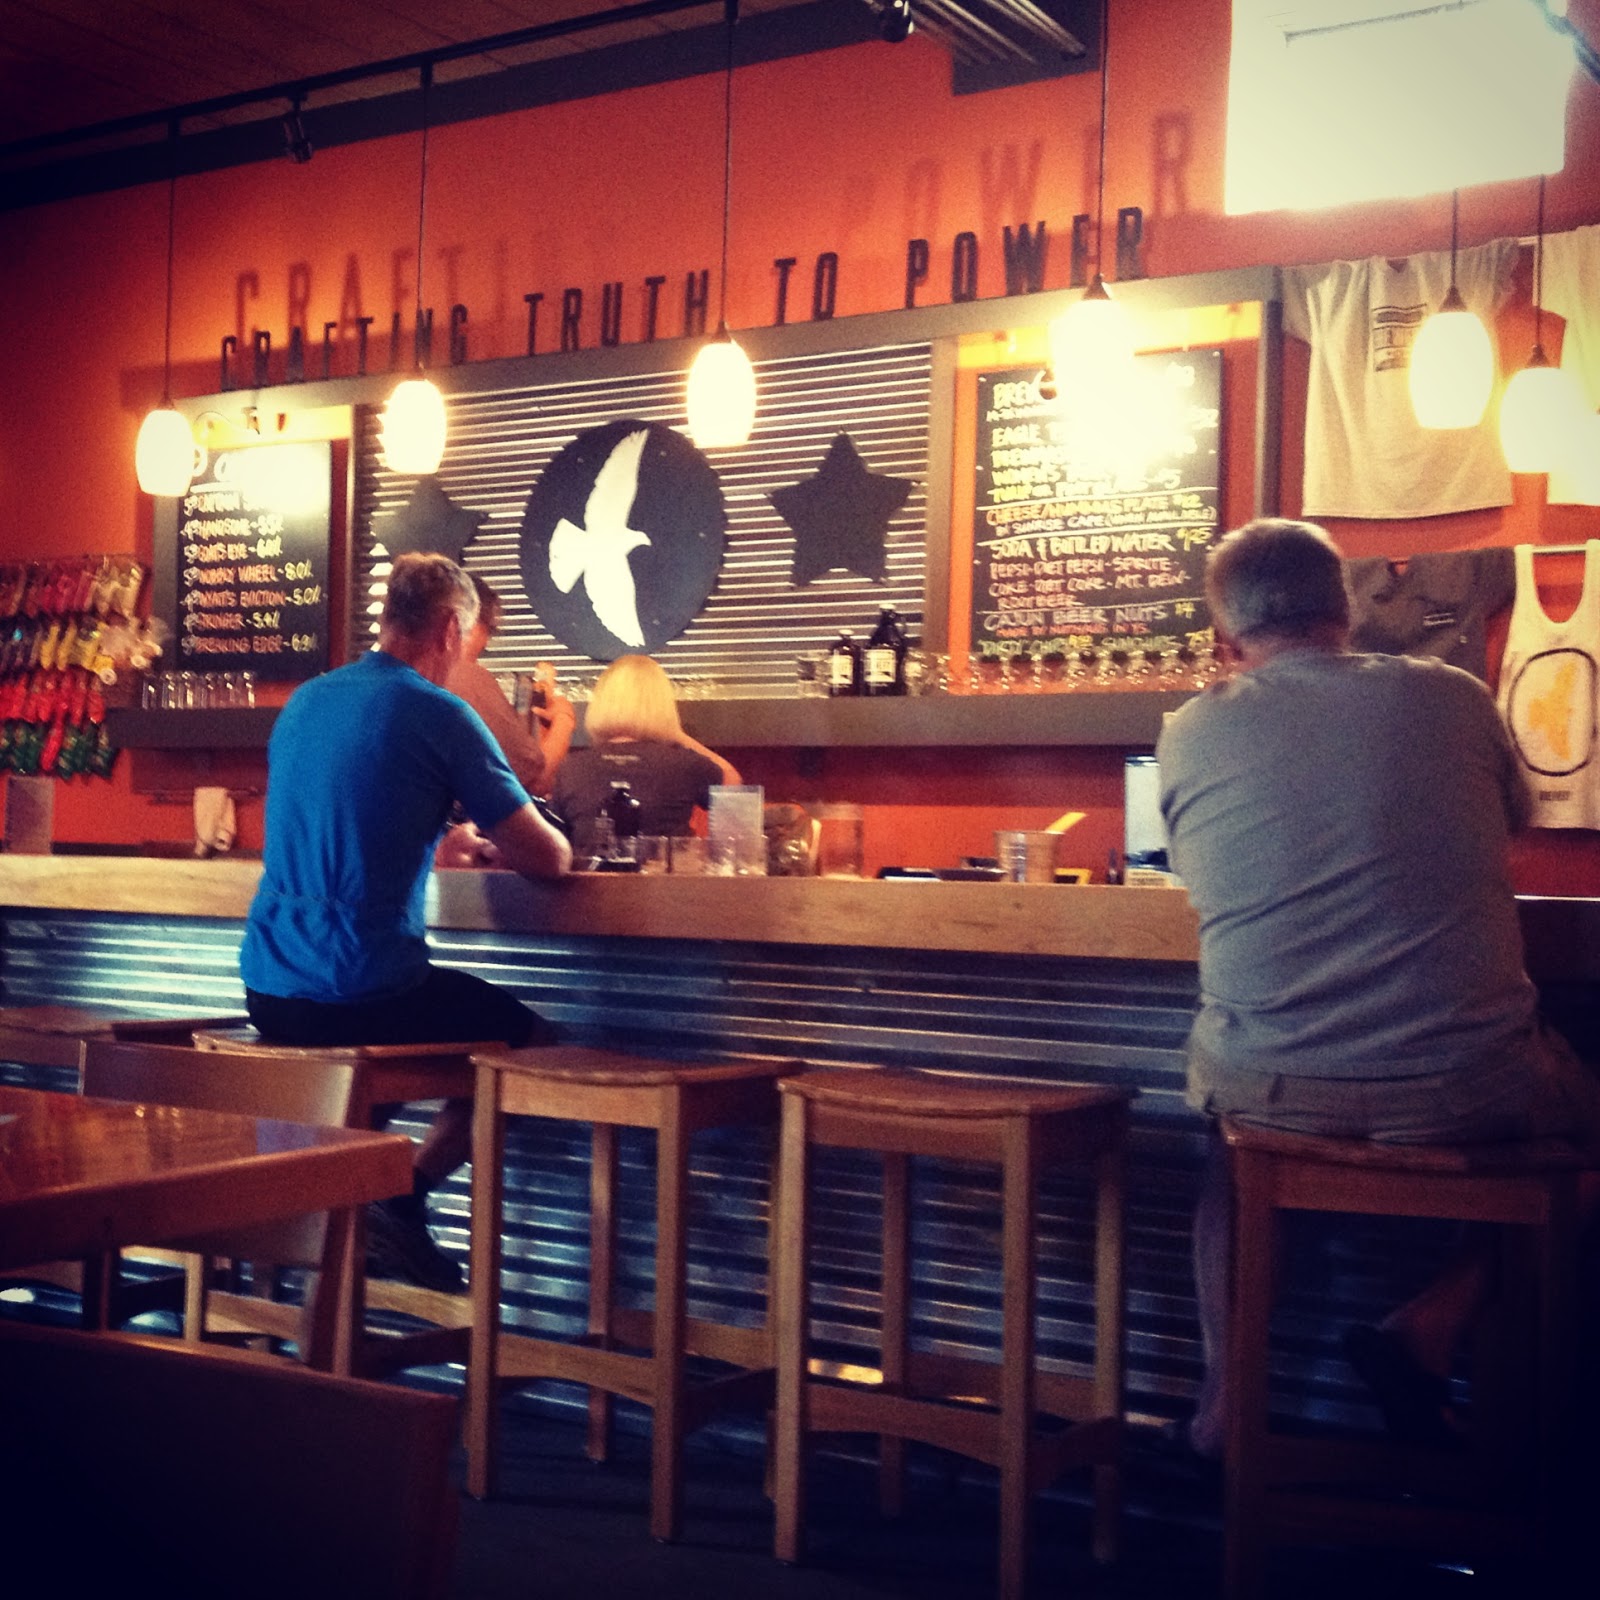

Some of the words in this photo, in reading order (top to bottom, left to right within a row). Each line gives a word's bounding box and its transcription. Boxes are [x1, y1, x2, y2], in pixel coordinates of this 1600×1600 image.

[220, 303, 468, 392] CRAFTING
[523, 269, 710, 357] TRUTH
[773, 251, 840, 327] TO
[905, 205, 1146, 310] POWER
[991, 541, 1034, 560] SODA
[1111, 531, 1178, 553] WATER
[998, 595, 1034, 611] ROOT
[1035, 593, 1086, 608] BEER
[983, 610, 1045, 632] CAJUN
[1052, 608, 1108, 626] BEER
[1114, 605, 1169, 624] NUTS
